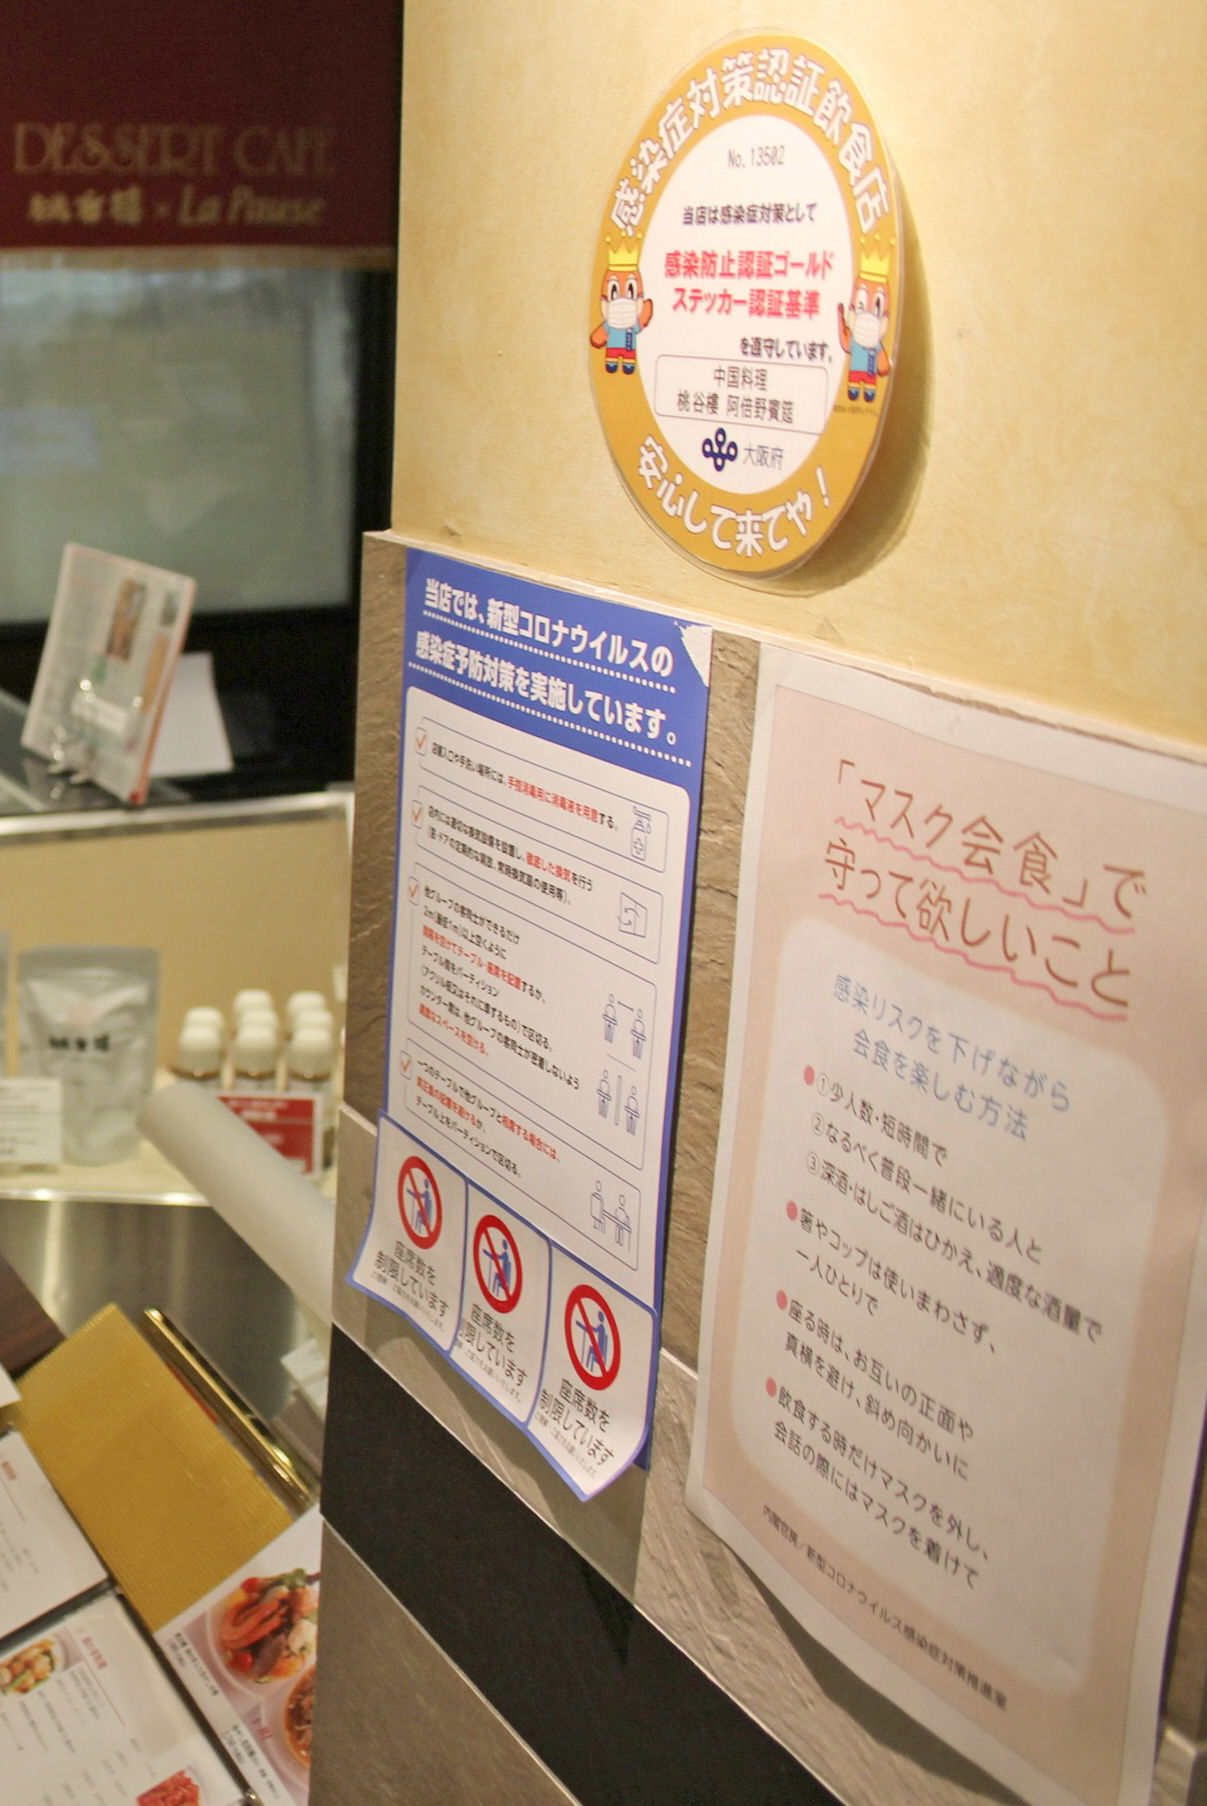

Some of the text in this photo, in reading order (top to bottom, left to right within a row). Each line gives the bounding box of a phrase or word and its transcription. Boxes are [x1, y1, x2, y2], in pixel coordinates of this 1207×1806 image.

[610, 48, 889, 234] 感染症対策認証飲食店
[682, 202, 818, 226] 当店は感染症対策として
[663, 250, 835, 282] 感染防止認証ゴールド
[672, 286, 821, 320] ステッカー認証基準
[714, 365, 768, 391] 中国料理
[743, 444, 784, 470] 大阪府
[424, 577, 674, 678] 当店では、新型コロナウイルスの
[415, 630, 677, 746] 感染症予防対策を実施しています。
[837, 758, 1148, 919] 「マスク会食」で
[824, 837, 1131, 1008] 守って欲しいこと
[833, 973, 1070, 1113] 感染リスクを下げながら
[853, 1028, 1029, 1141] 会食を楽しむ方法
[374, 1249, 449, 1319] 制限しています
[394, 1240, 437, 1286] 座席数を
[796, 1248, 879, 1317] 一人ひとりで
[799, 1207, 996, 1354] 箸やコップは使いまわさず、
[471, 1303, 515, 1354] 座席数を
[788, 1299, 974, 1442] 座る時は、お互いの正面や
[538, 1388, 615, 1467] 制限しています
[561, 1378, 611, 1434] 座席数を
[784, 1331, 969, 1481] 真横を避け、斜め向かいに
[774, 1420, 980, 1590] 会話の際にはマスクを着けて
[778, 1387, 990, 1561] 飲食する時だけマスクを外し、
